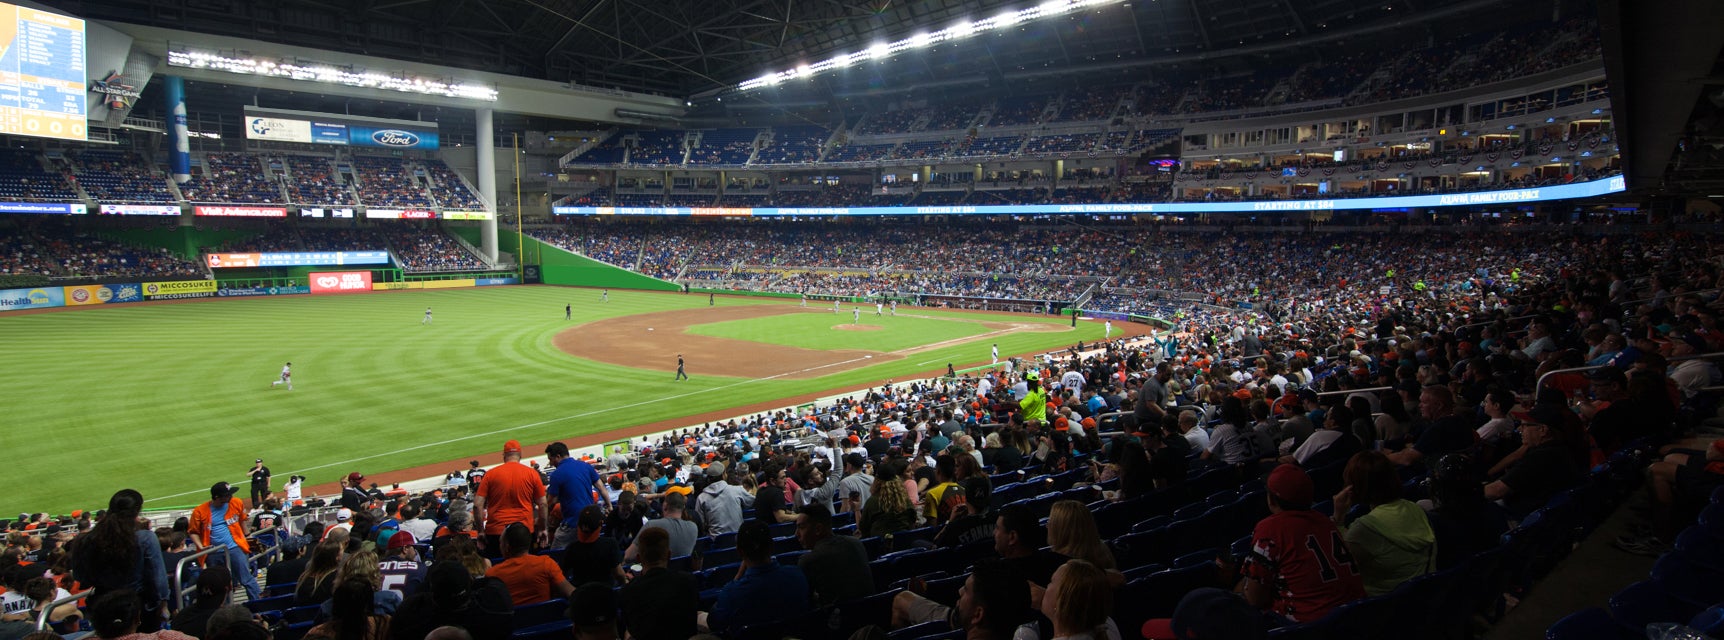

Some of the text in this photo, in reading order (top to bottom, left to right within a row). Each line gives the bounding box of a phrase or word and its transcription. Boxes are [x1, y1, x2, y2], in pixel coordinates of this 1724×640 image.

[381, 130, 410, 144] Ford
[1470, 193, 1497, 202] FAMILY
[1254, 202, 1300, 210] STARTING
[200, 207, 283, 216] Visit Avianca.com
[150, 292, 214, 300] #MICCOSUKEELIFE
[1, 297, 49, 306] HealthSun
[1305, 530, 1361, 583] 14
[382, 574, 406, 600] 5
